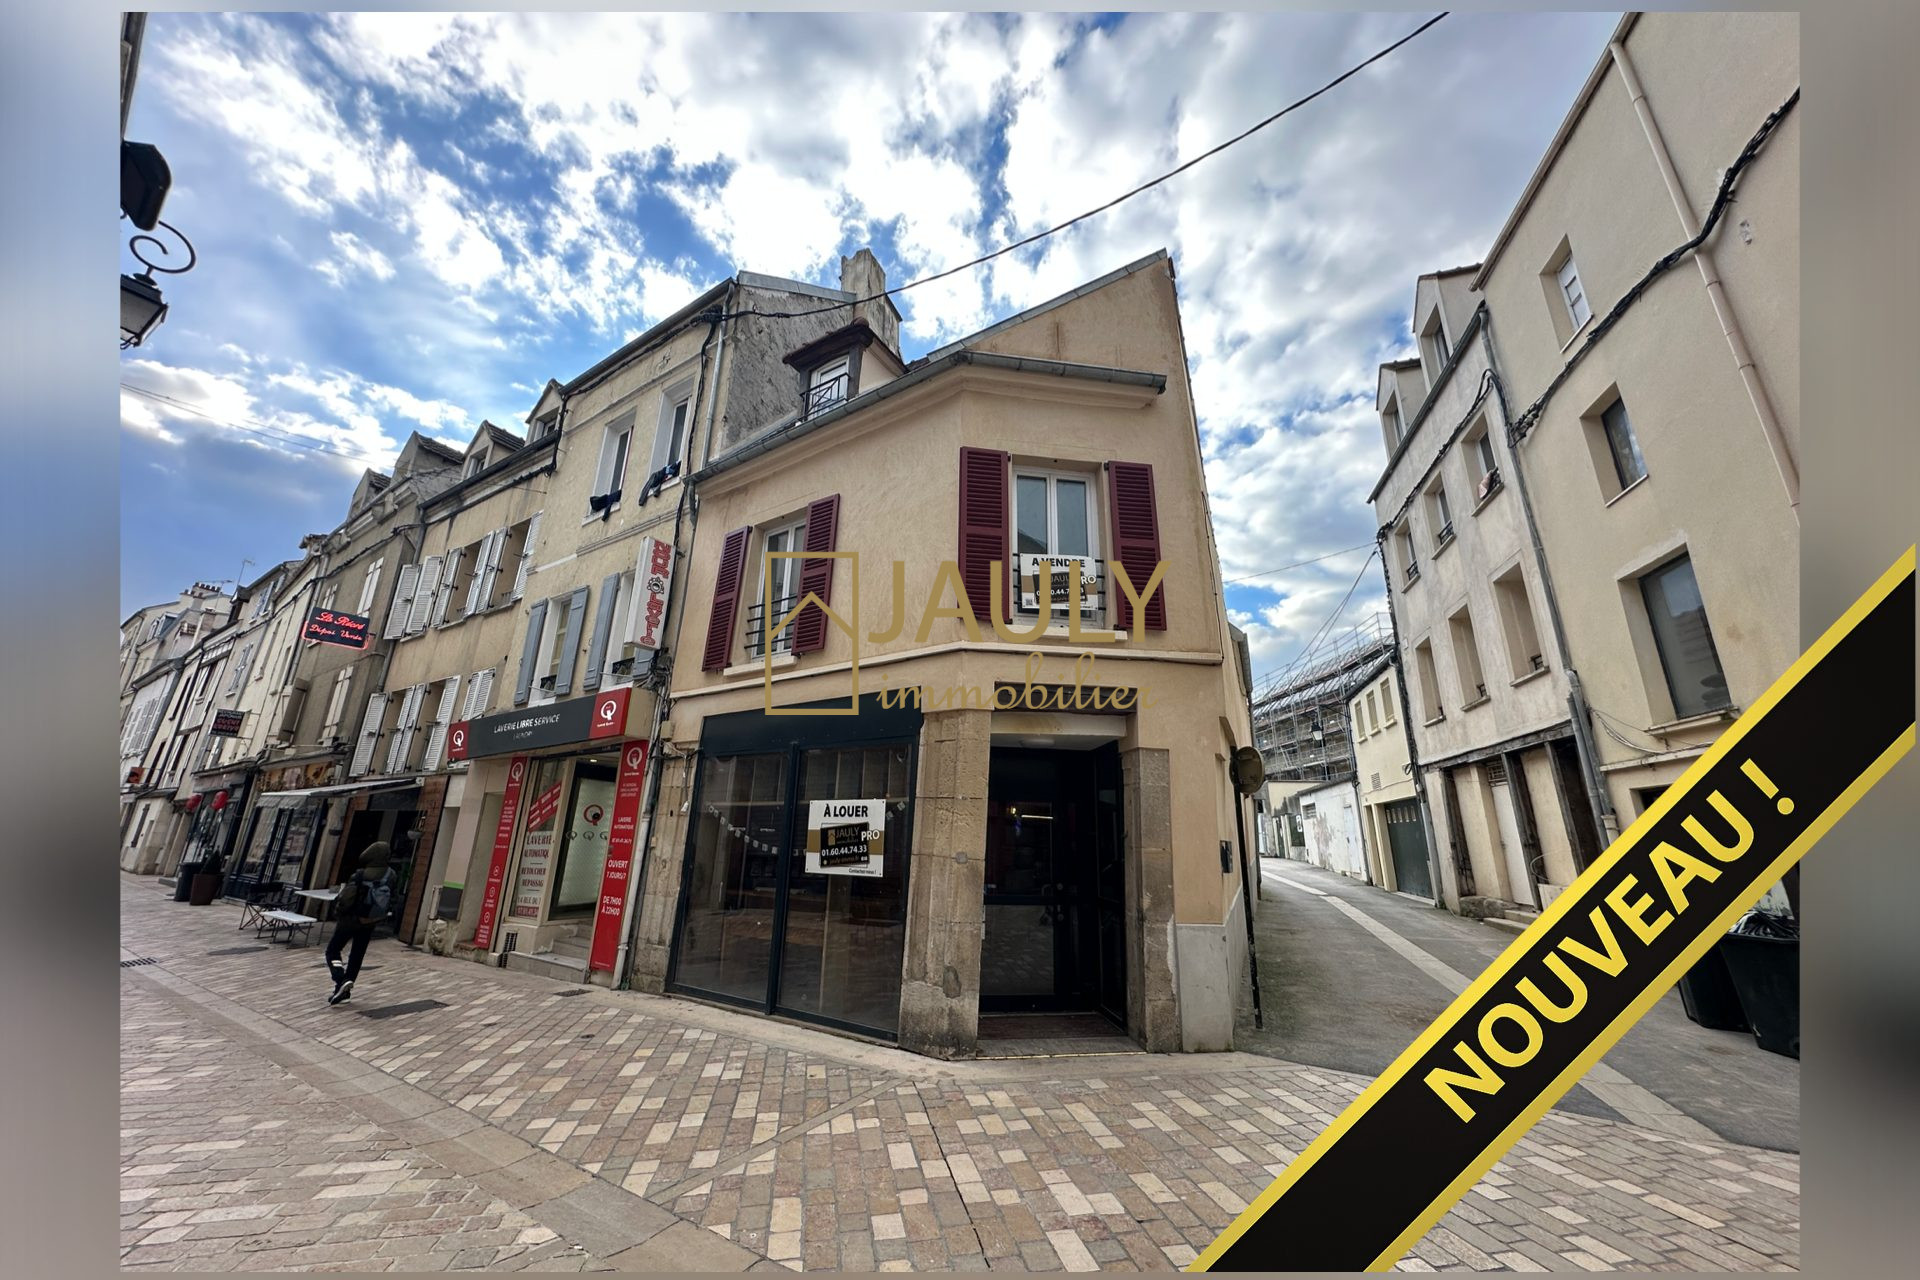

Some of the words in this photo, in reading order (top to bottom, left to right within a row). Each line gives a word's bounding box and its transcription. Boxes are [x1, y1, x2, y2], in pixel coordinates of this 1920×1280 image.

[1081, 575, 1097, 585] RO
[494, 721, 516, 733] LAVERIE
[516, 718, 534, 730] LIBRE
[534, 713, 561, 727] SERVICE
[823, 803, 831, 818] À
[833, 805, 868, 818] LOUER
[836, 826, 860, 839] JAULY
[861, 829, 880, 841] PRO
[821, 844, 868, 857] 01.60.44.74.33
[608, 860, 628, 869] OUVERT
